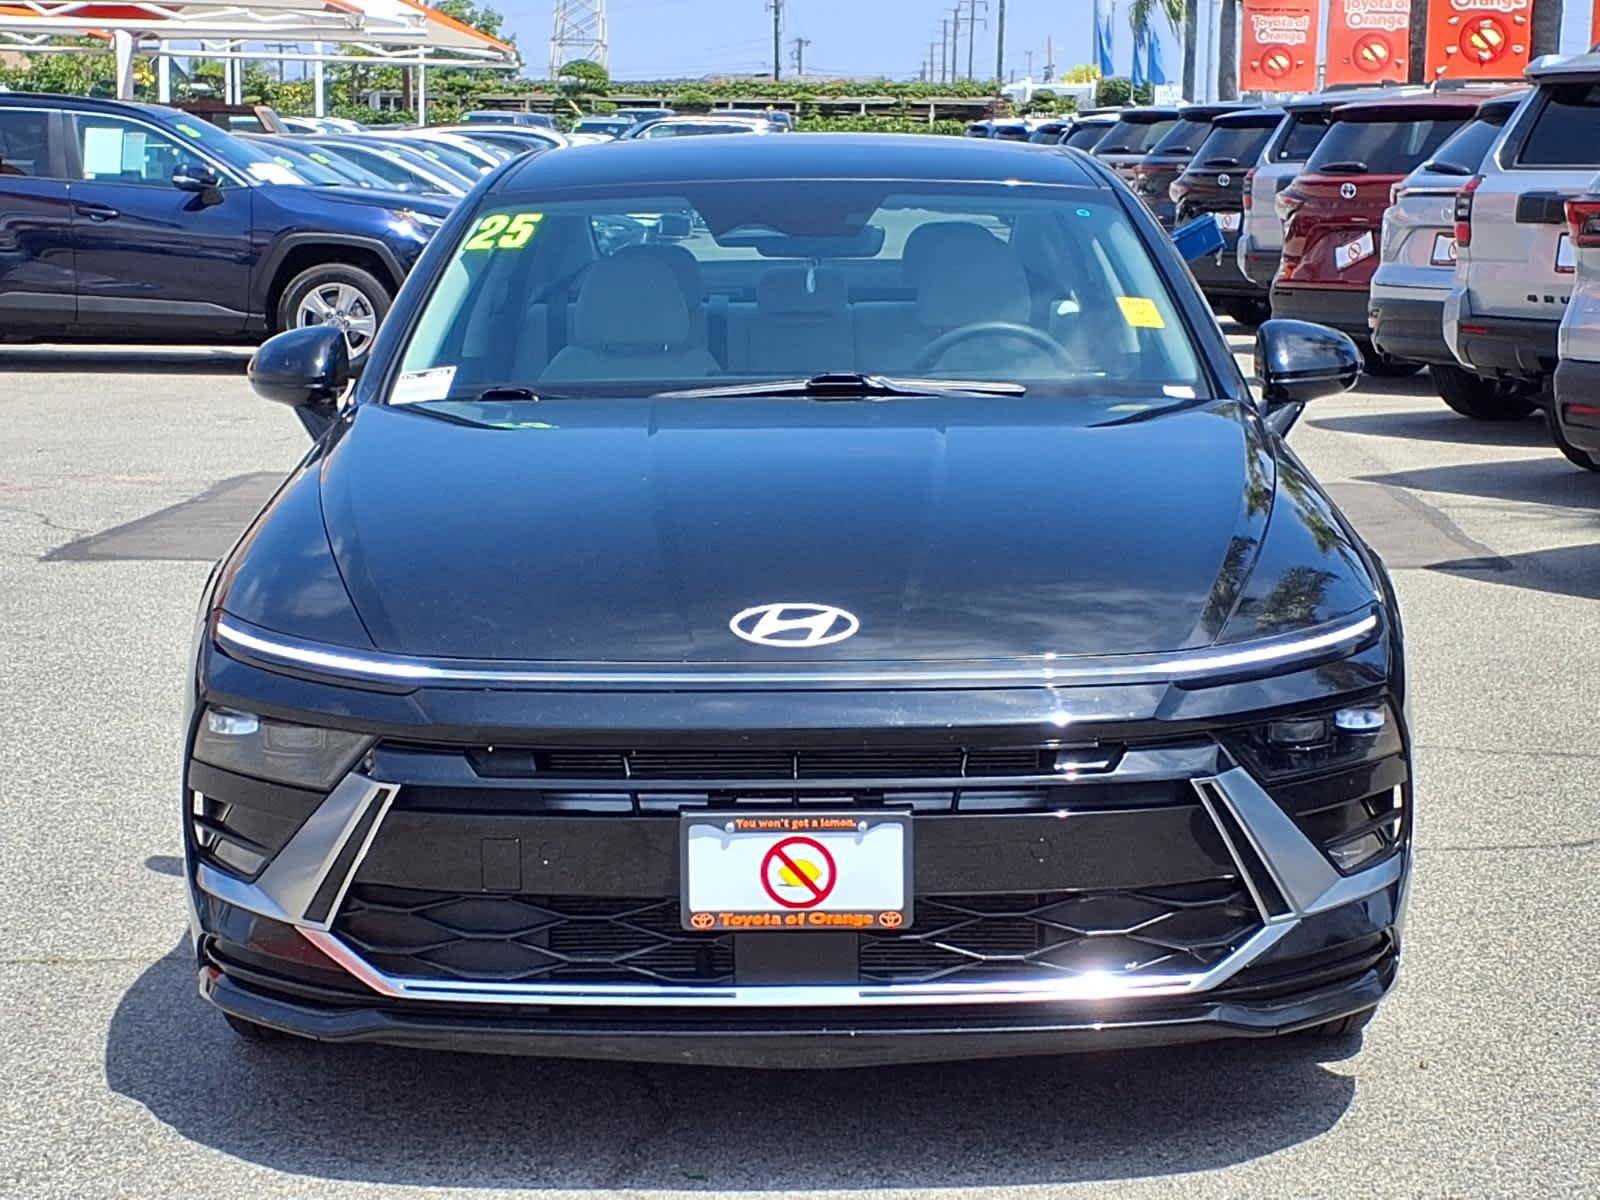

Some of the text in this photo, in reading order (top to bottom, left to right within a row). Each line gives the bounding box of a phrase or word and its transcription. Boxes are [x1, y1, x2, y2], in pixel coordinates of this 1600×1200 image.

[1251, 15, 1294, 31] Toyota
[1346, 11, 1408, 31] Orange
[1256, 29, 1305, 44] Orange
[464, 212, 544, 250] 25
[736, 818, 756, 829] You
[758, 818, 789, 828] won't
[811, 820, 819, 828] a
[820, 818, 857, 828] lemon.
[719, 911, 874, 927] Toyota of Orange
